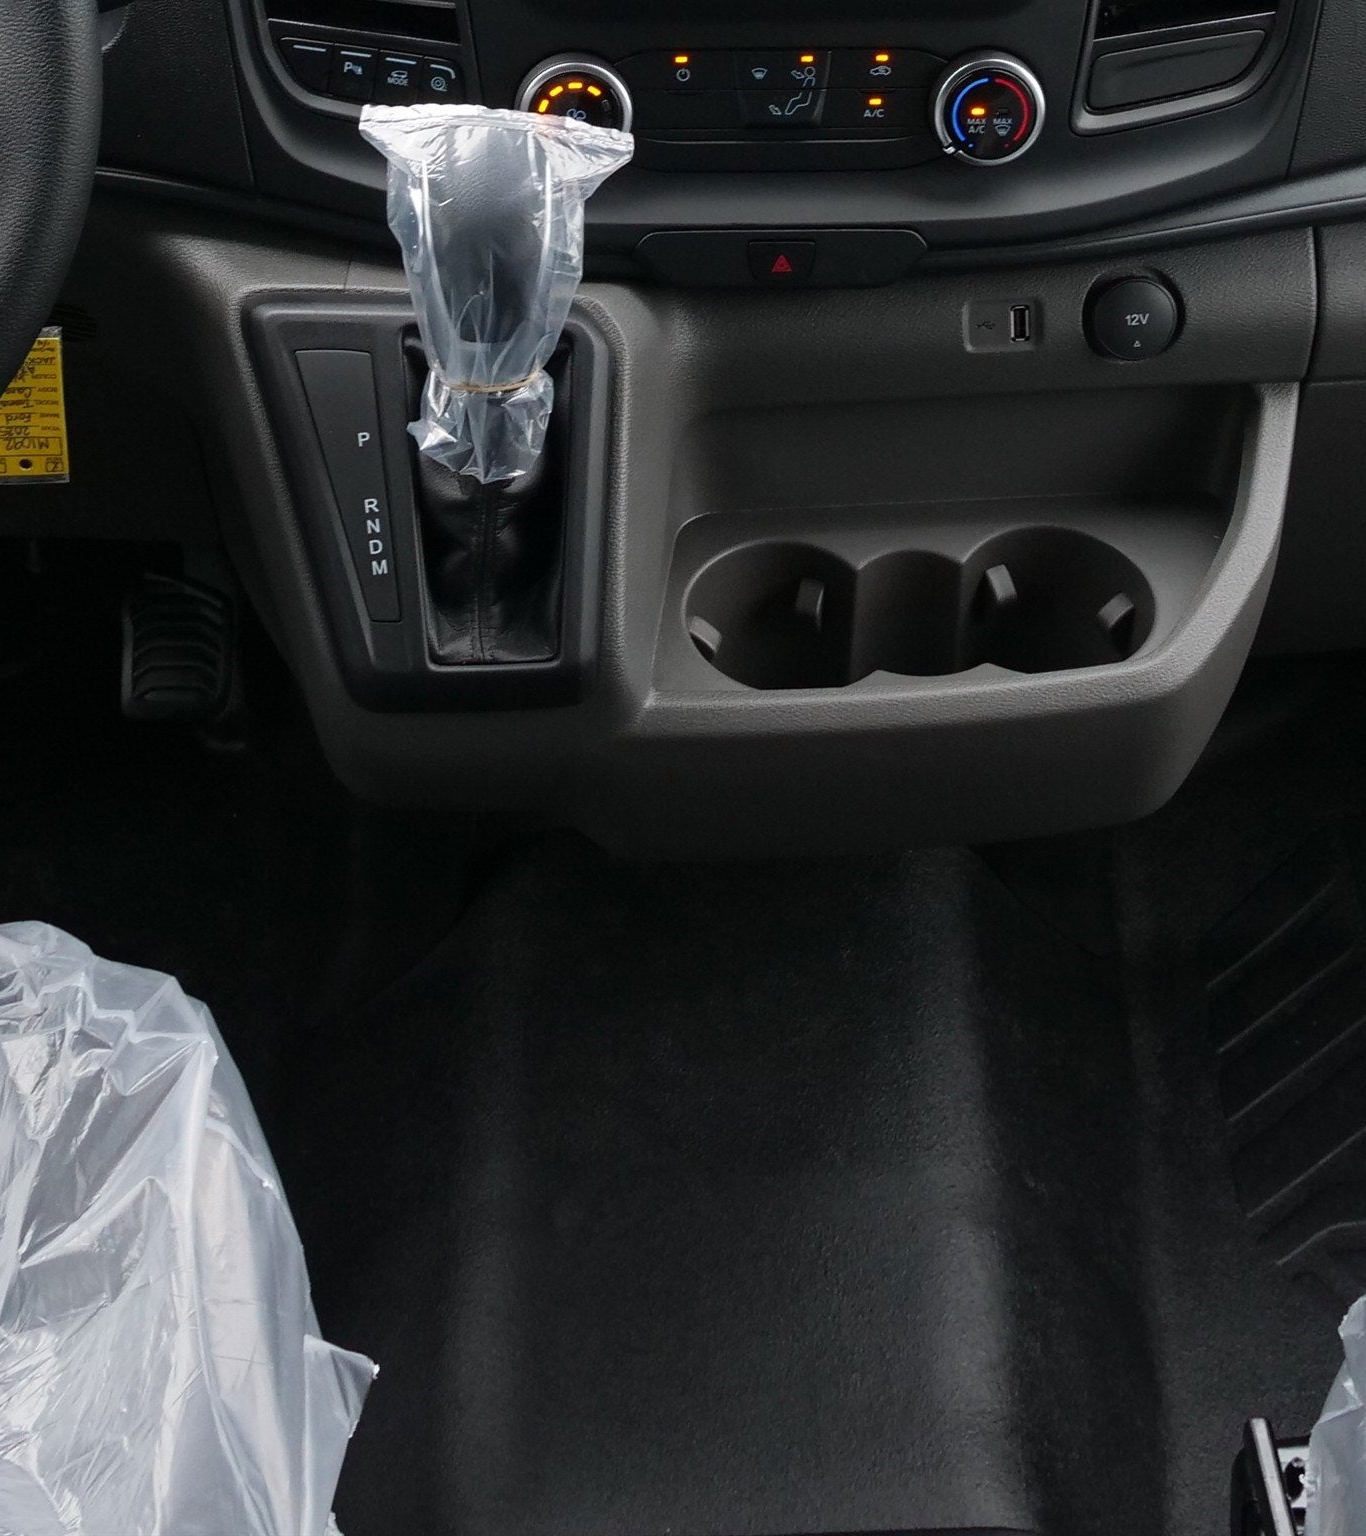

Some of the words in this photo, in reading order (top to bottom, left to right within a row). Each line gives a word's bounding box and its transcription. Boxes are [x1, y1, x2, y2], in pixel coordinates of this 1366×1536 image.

[387, 76, 410, 87] MODE
[863, 108, 885, 119] A/C
[968, 124, 986, 135] A/C
[1124, 313, 1150, 326] 12V
[357, 431, 371, 448] P
[363, 498, 380, 514] R
[365, 518, 382, 535] N
[368, 539, 384, 555] D
[371, 559, 389, 576] M
